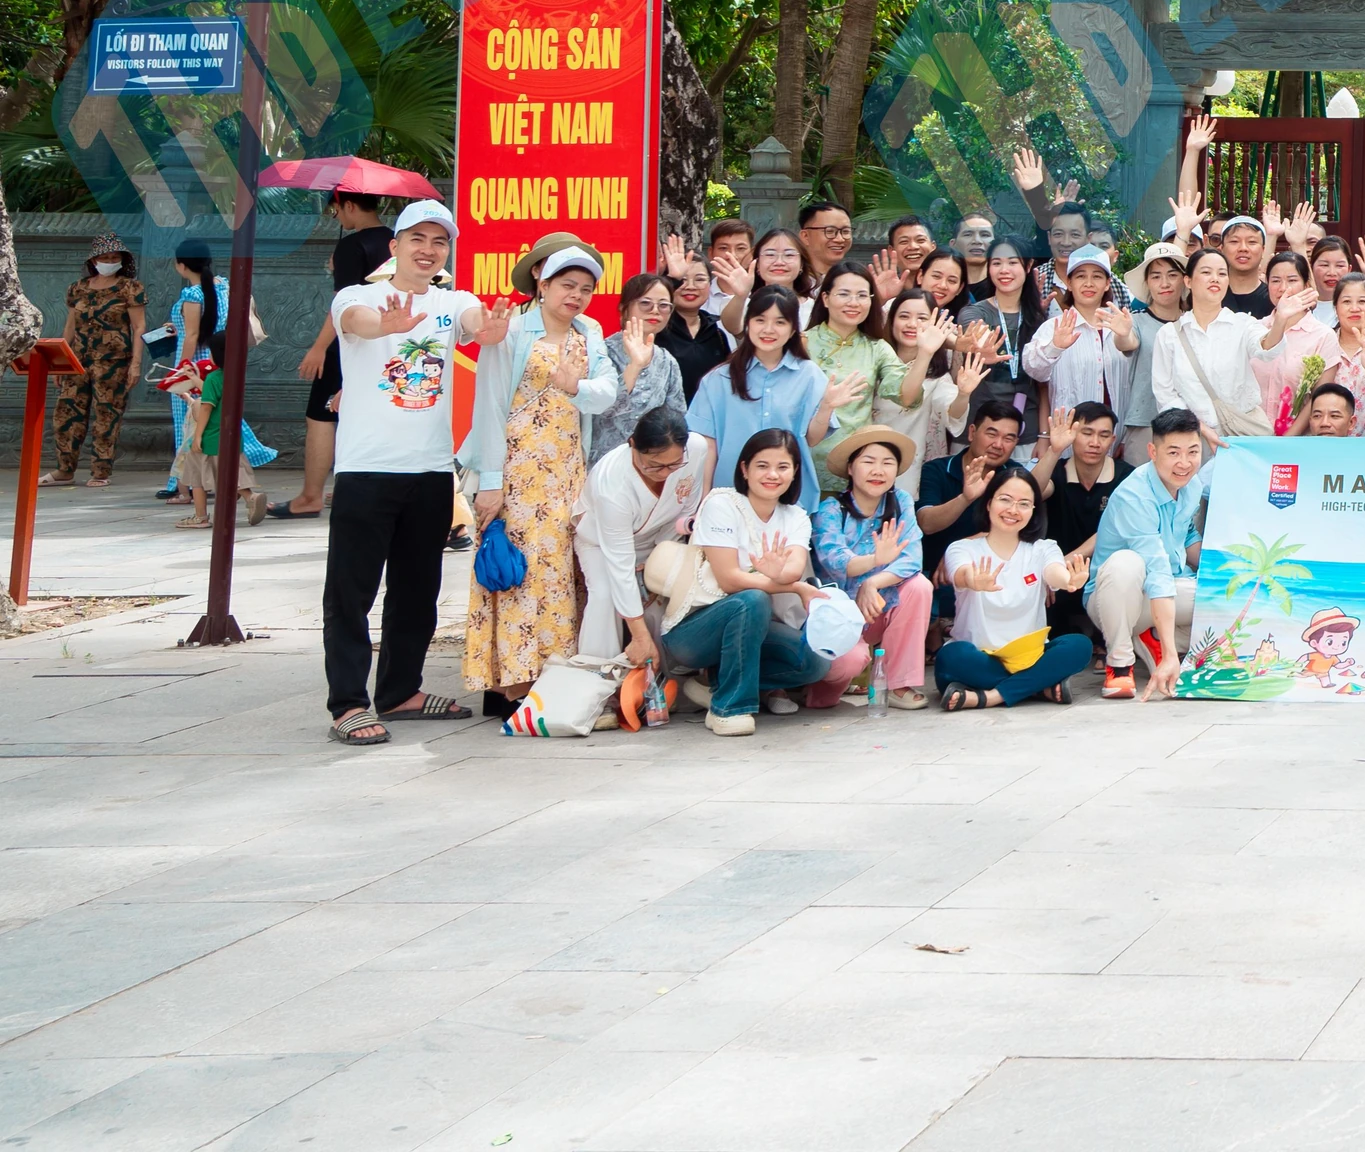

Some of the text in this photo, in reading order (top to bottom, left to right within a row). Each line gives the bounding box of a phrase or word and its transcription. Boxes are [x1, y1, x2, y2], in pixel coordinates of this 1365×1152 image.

[105, 29, 229, 54] LỐI ĐI THAM QUAN
[486, 13, 621, 80] CỘNG SẢN
[107, 58, 223, 69] VISITORS FOLLOW THIS WAY
[489, 93, 613, 154] VIỆT NAM
[470, 177, 628, 225] QUANG VINH
[435, 314, 451, 328] 16
